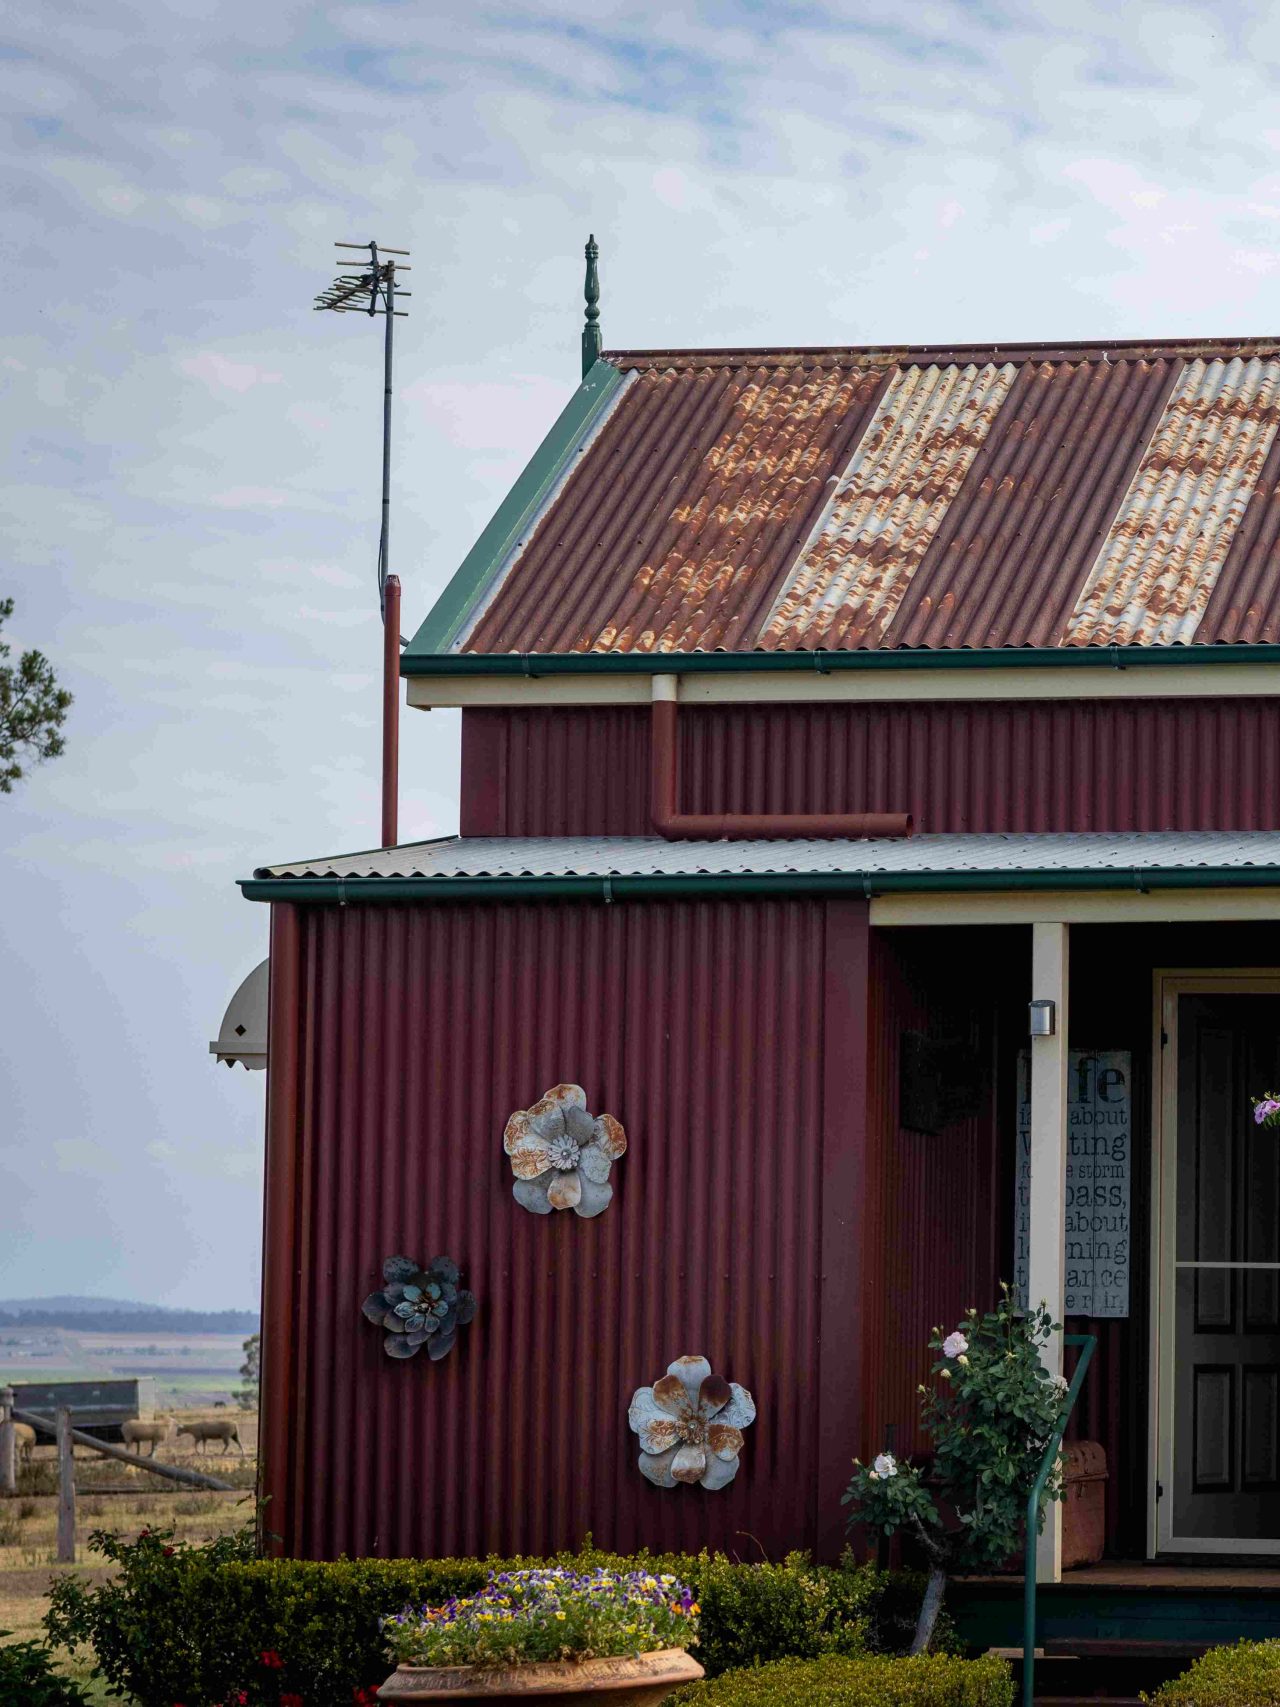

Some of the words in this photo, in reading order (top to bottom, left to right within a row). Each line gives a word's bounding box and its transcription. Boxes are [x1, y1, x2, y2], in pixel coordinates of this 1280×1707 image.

[1021, 1057, 1126, 1104] fe
[1070, 1106, 1128, 1126] about
[1078, 1164, 1126, 1179] storm
[1065, 1210, 1128, 1233] about
[1065, 1269, 1127, 1288] ance
